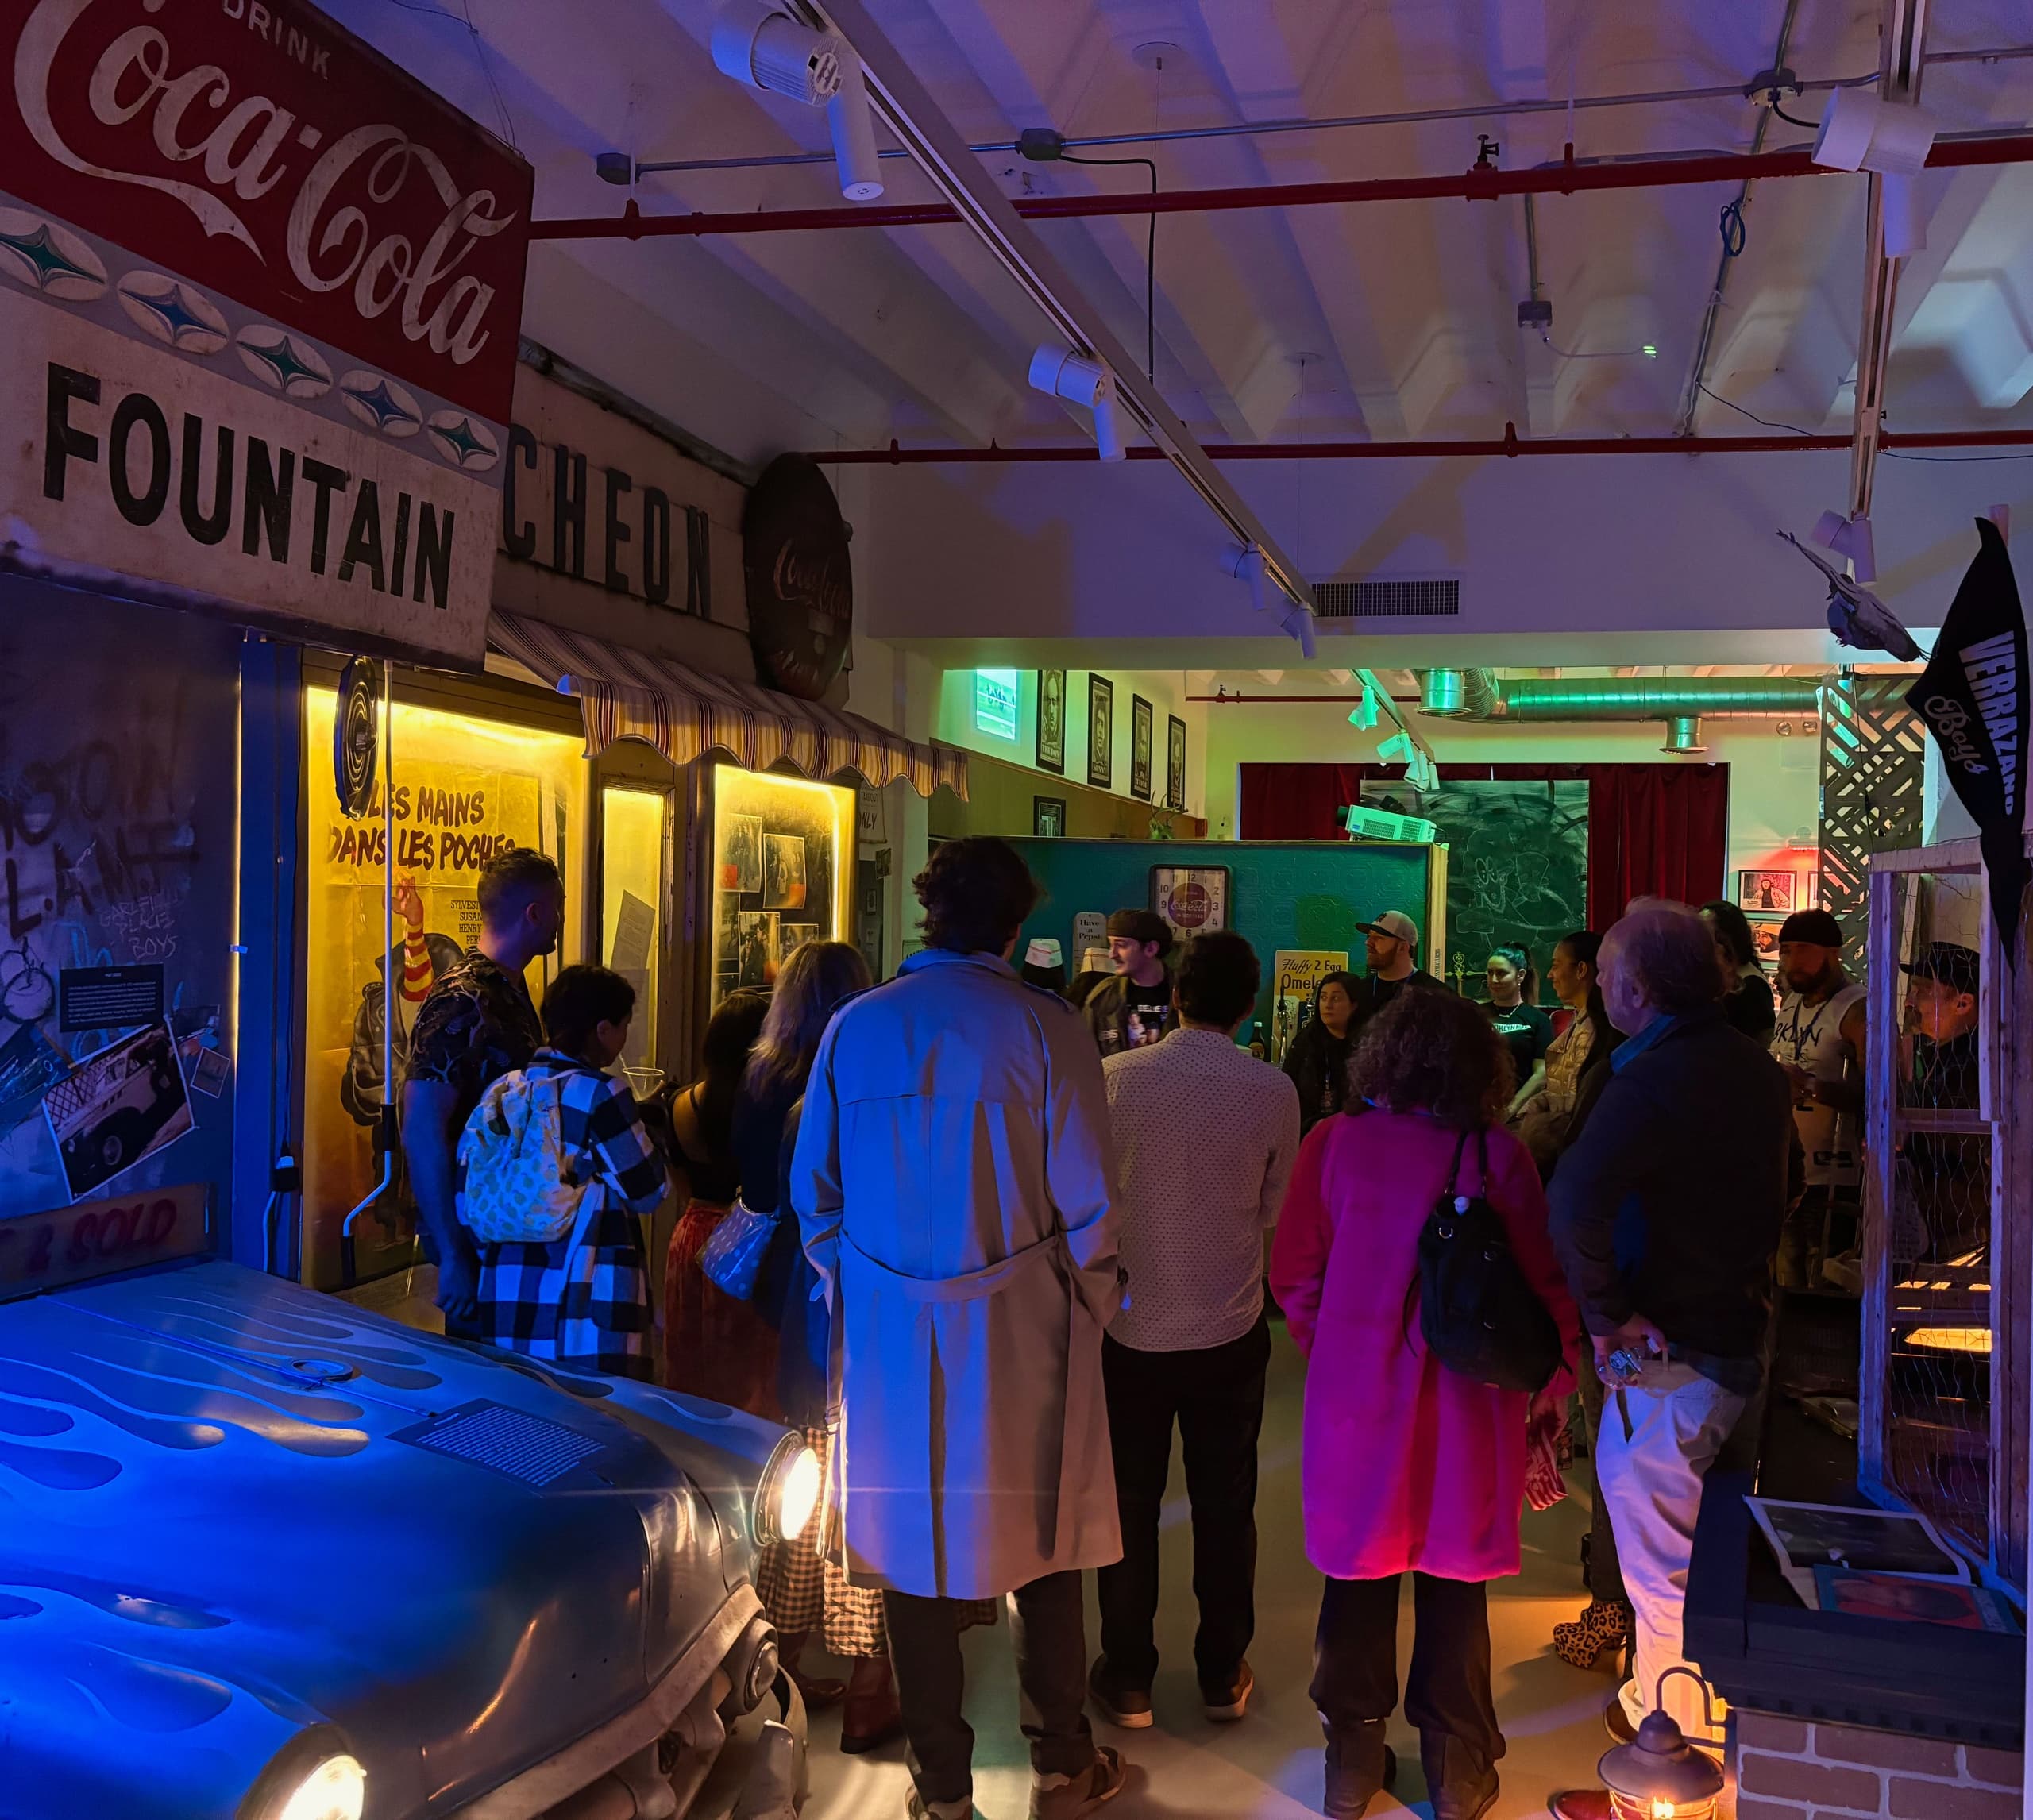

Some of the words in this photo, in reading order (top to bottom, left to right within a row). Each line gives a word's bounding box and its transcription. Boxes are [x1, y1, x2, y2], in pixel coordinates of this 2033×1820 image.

[14, 0, 517, 364] Coca-Cola
[43, 361, 455, 610] FOUNTAIN
[1958, 630, 2018, 816] VERRAZANO
[1924, 696, 1989, 775] Boys
[368, 778, 411, 821] LES
[417, 785, 485, 828] MAINS
[325, 823, 387, 868] DANS
[397, 827, 435, 871] LES
[1160, 884, 1168, 893] 10
[1213, 886, 1220, 895] 2
[1161, 900, 1167, 909] 9
[1212, 902, 1219, 911] 3
[459, 912, 482, 922] SUSAN
[1212, 918, 1217, 927] 4
[458, 923, 482, 933] HENRY
[1186, 928, 1192, 937] 6
[465, 935, 480, 945] PER
[1282, 958, 1312, 974] Fluffy
[1314, 960, 1321, 971] 2
[1325, 960, 1341, 972] Egg
